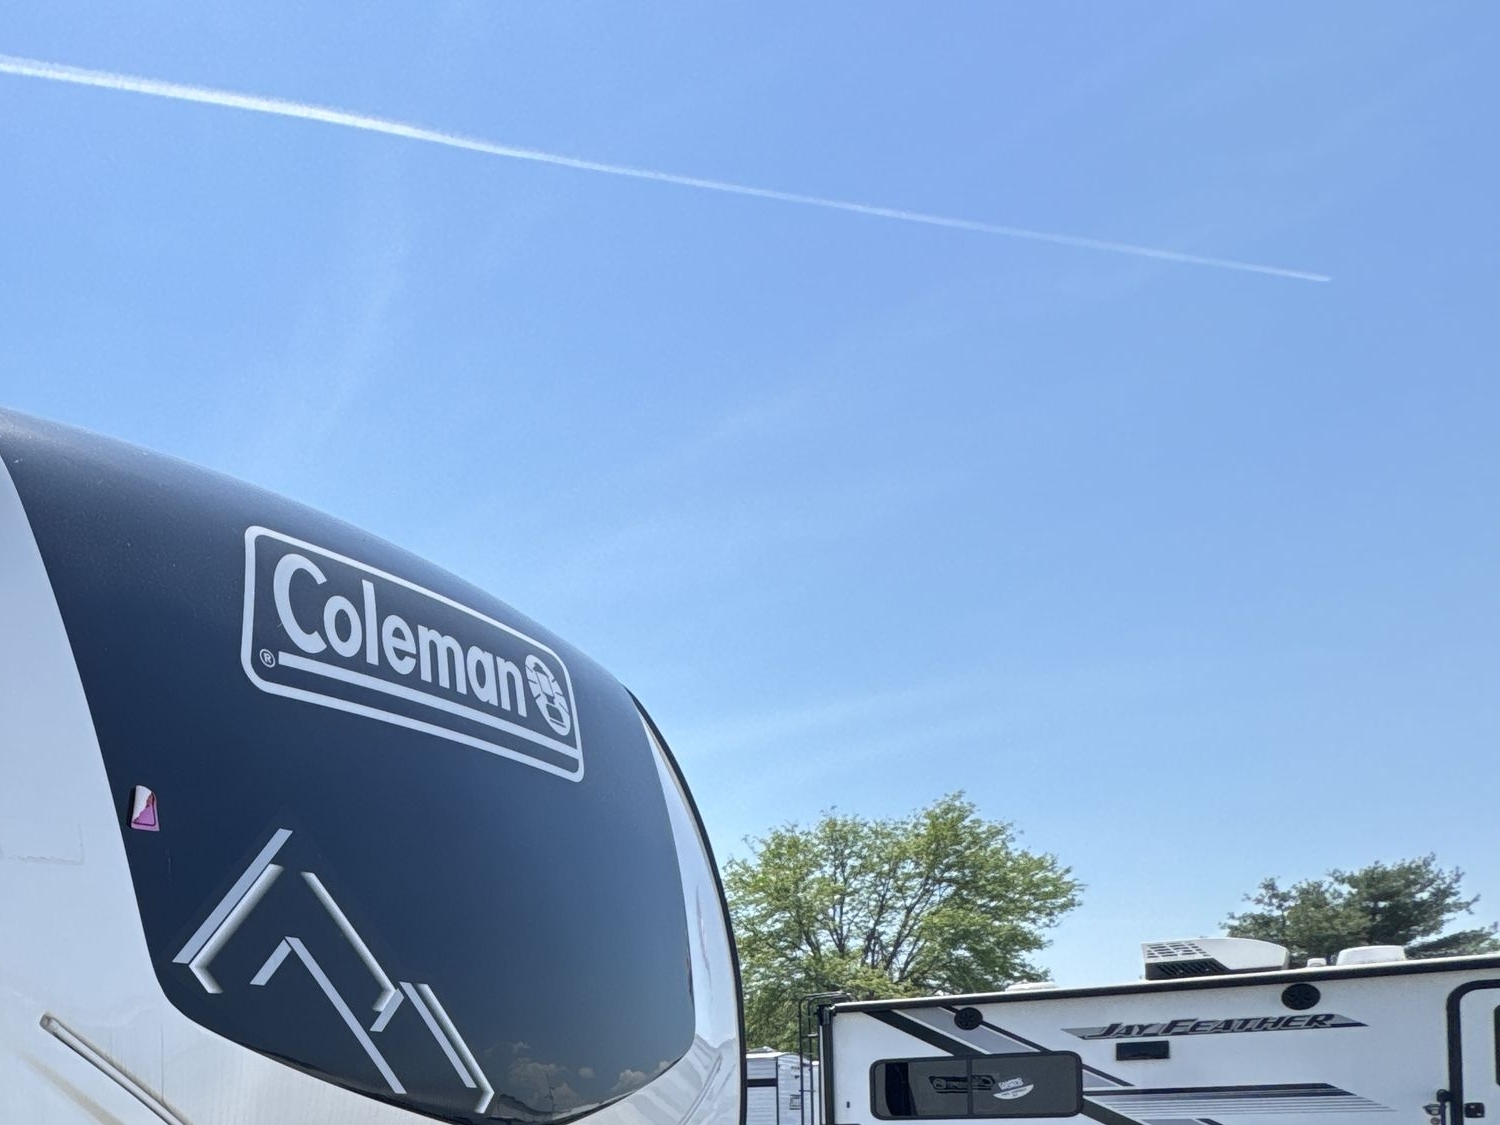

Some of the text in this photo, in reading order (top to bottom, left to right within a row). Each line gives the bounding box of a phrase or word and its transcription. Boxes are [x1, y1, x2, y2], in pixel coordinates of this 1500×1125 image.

[273, 553, 527, 717] Coleman
[1087, 1013, 1335, 1040] JAY FEATHER
